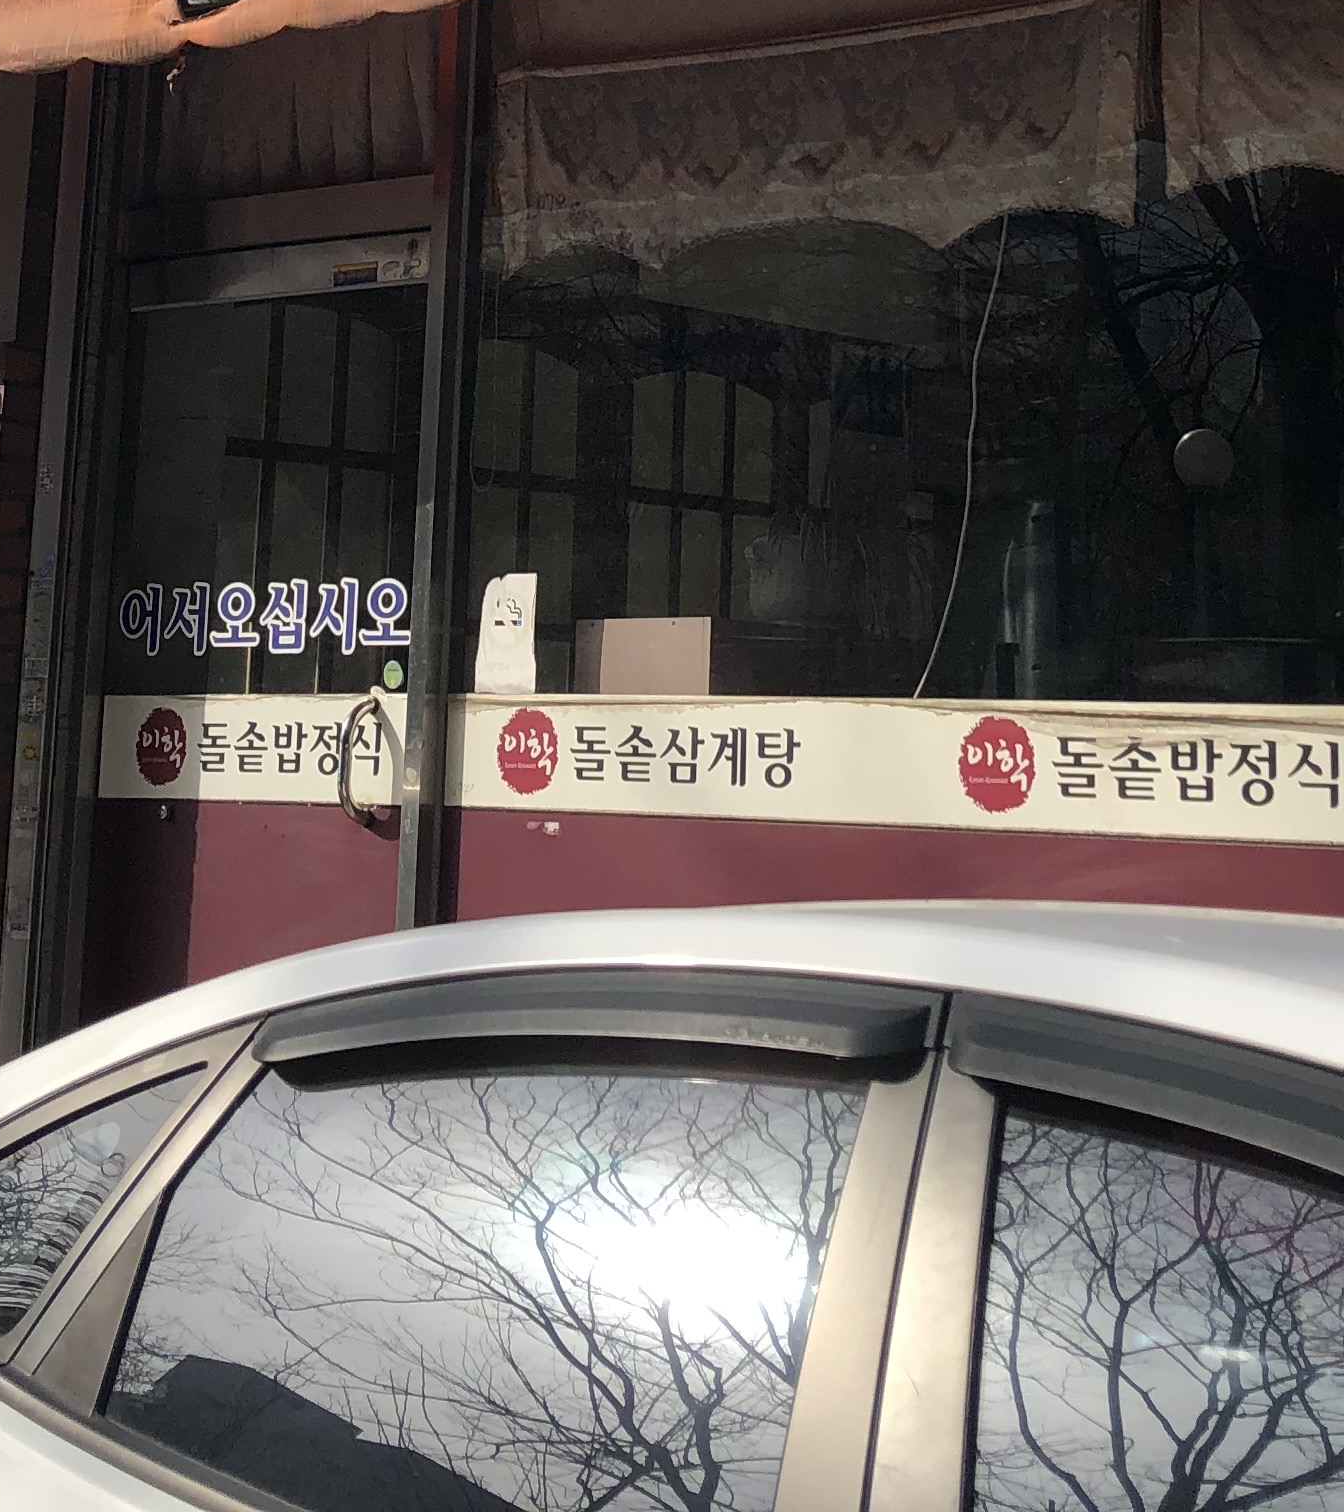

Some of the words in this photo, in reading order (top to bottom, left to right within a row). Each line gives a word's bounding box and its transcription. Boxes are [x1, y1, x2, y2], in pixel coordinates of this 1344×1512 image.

[119, 576, 412, 657] 어서오십시오
[197, 721, 383, 777] 돌솥밥정식
[569, 724, 802, 789] 돌솥삼계탕
[1051, 735, 1341, 809] 돌솥밥정식
